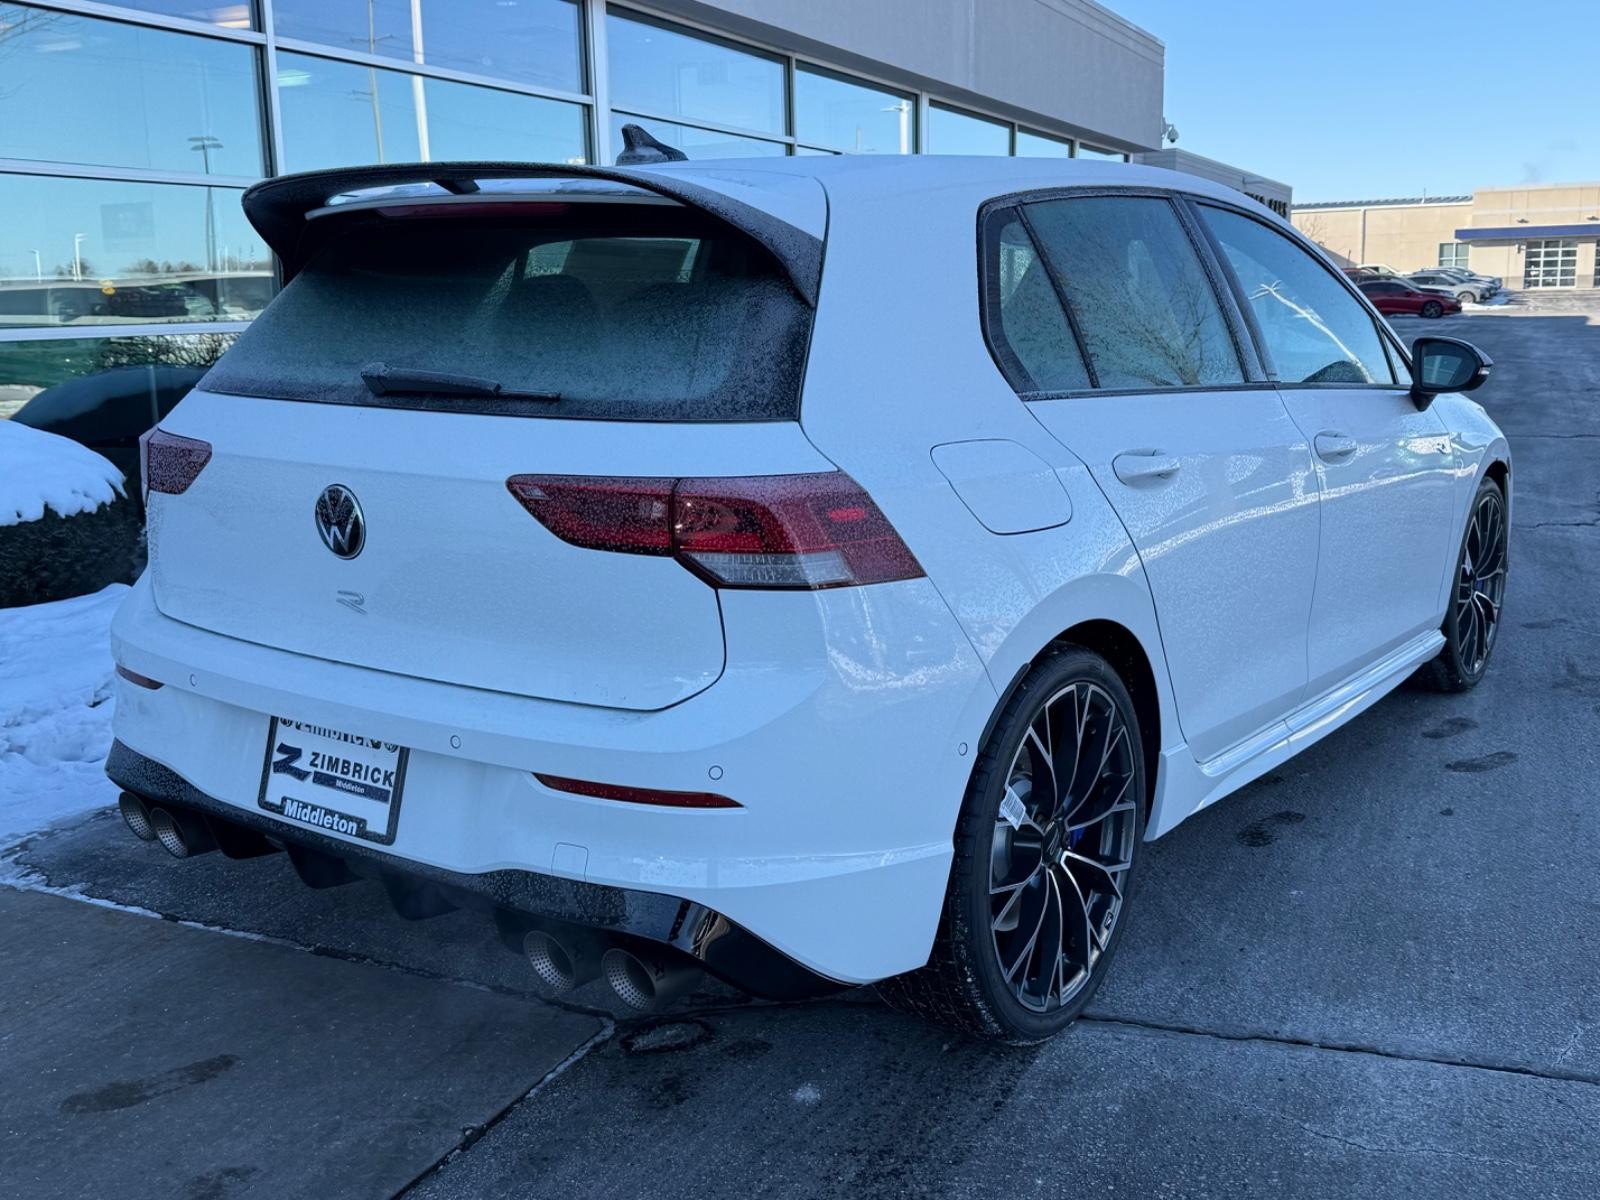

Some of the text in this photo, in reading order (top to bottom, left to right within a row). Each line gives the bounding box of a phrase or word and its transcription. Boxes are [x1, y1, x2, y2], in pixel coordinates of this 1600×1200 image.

[309, 752, 395, 787] ZIMBRICK
[335, 779, 365, 793] Middleton
[283, 799, 358, 835] Middleton
